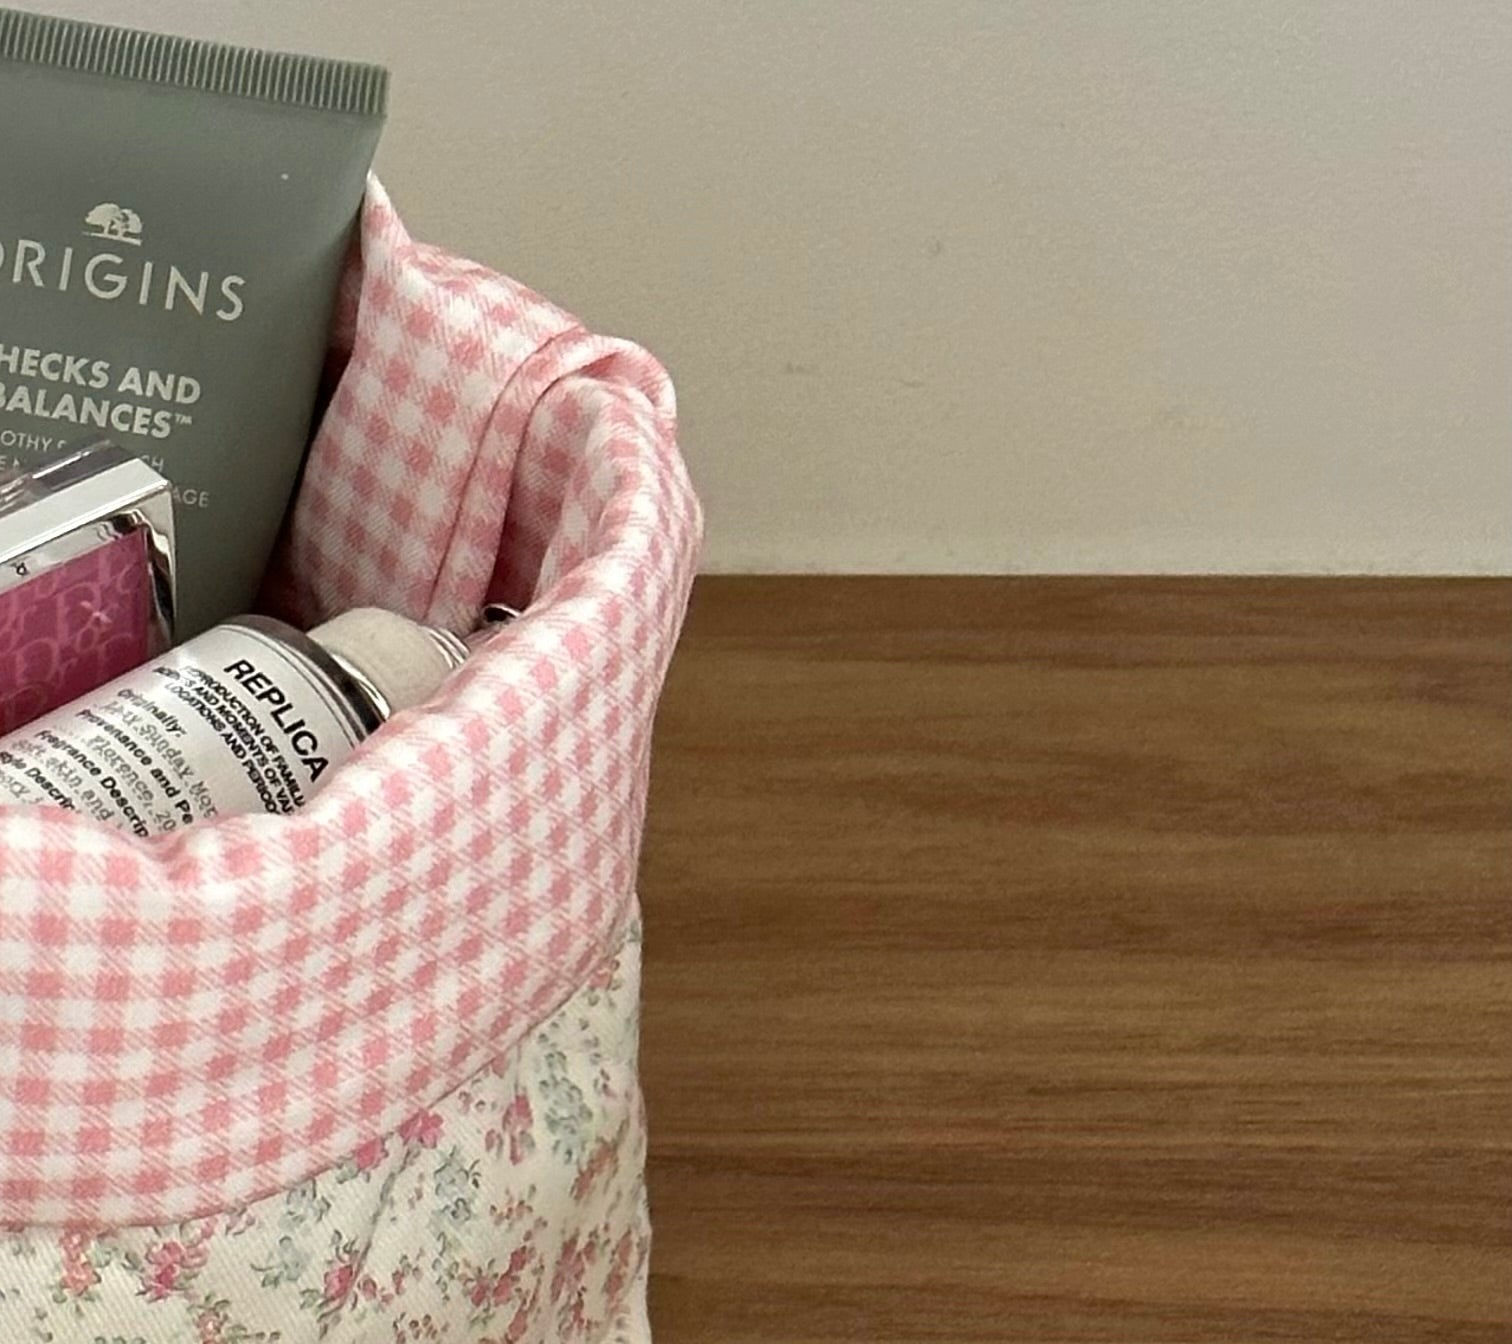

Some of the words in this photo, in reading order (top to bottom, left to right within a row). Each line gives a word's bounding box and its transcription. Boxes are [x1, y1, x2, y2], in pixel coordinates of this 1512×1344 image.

[118, 367, 201, 404] AND
[164, 684, 227, 733] LOCATIONS
[220, 733, 247, 759] AND
[191, 687, 219, 706] AND
[214, 705, 269, 767] MOMENTS
[264, 767, 282, 787] OF
[223, 659, 329, 783] REPLICA
[260, 736, 280, 754] OF
[33, 729, 103, 777] Fragrance
[150, 766, 181, 799] and
